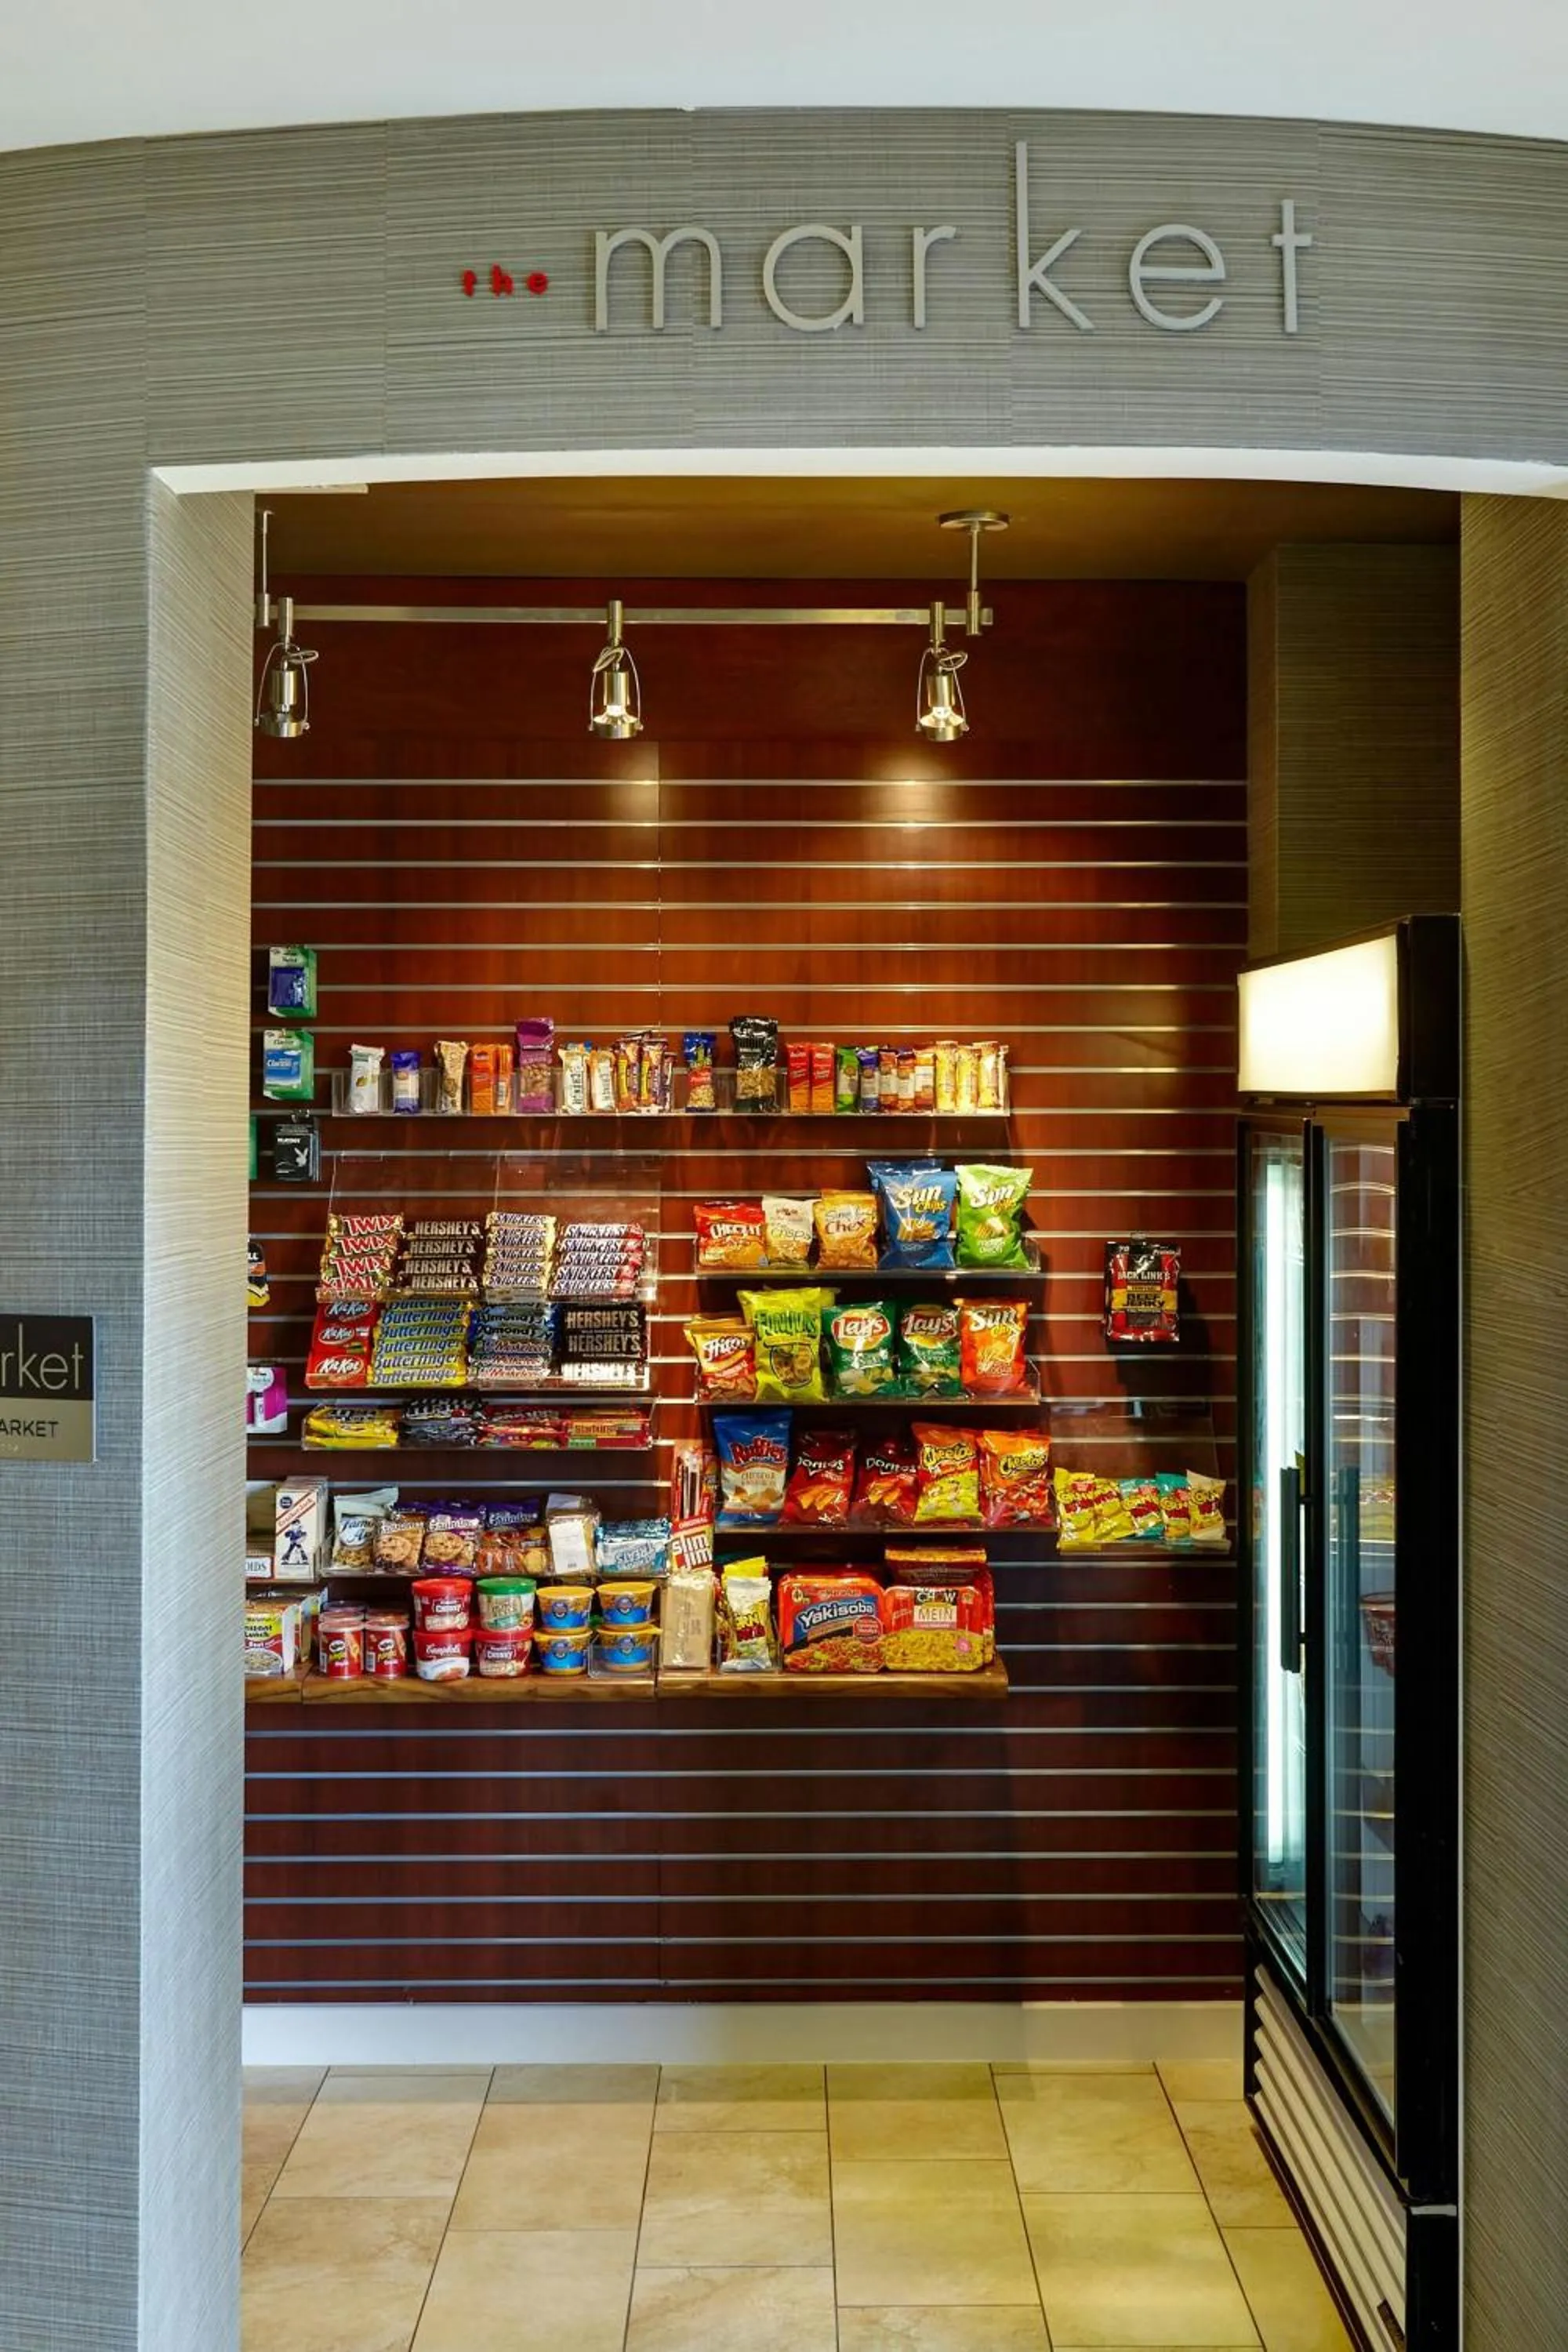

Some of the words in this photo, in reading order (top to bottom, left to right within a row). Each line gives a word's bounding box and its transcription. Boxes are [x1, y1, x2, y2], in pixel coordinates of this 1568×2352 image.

[461, 265, 550, 297] the
[595, 141, 1314, 333] market
[895, 1185, 942, 1208] Sun
[342, 1215, 401, 1236] TWIX
[415, 1221, 481, 1236] HERSHEY'S
[825, 1220, 866, 1235] Chex
[410, 1240, 477, 1254] HERSHEY'S
[405, 1258, 472, 1275] HERSHEY'S
[557, 1266, 616, 1279] SNICKERS
[412, 1275, 477, 1288] HERSHEY'S
[567, 1309, 639, 1328] HERSHEY'S
[969, 1308, 1018, 1331] Sun
[568, 1333, 641, 1352] HERSHEY'S
[798, 1601, 874, 1628] Yakisoba
[918, 1607, 953, 1621] MEIN
